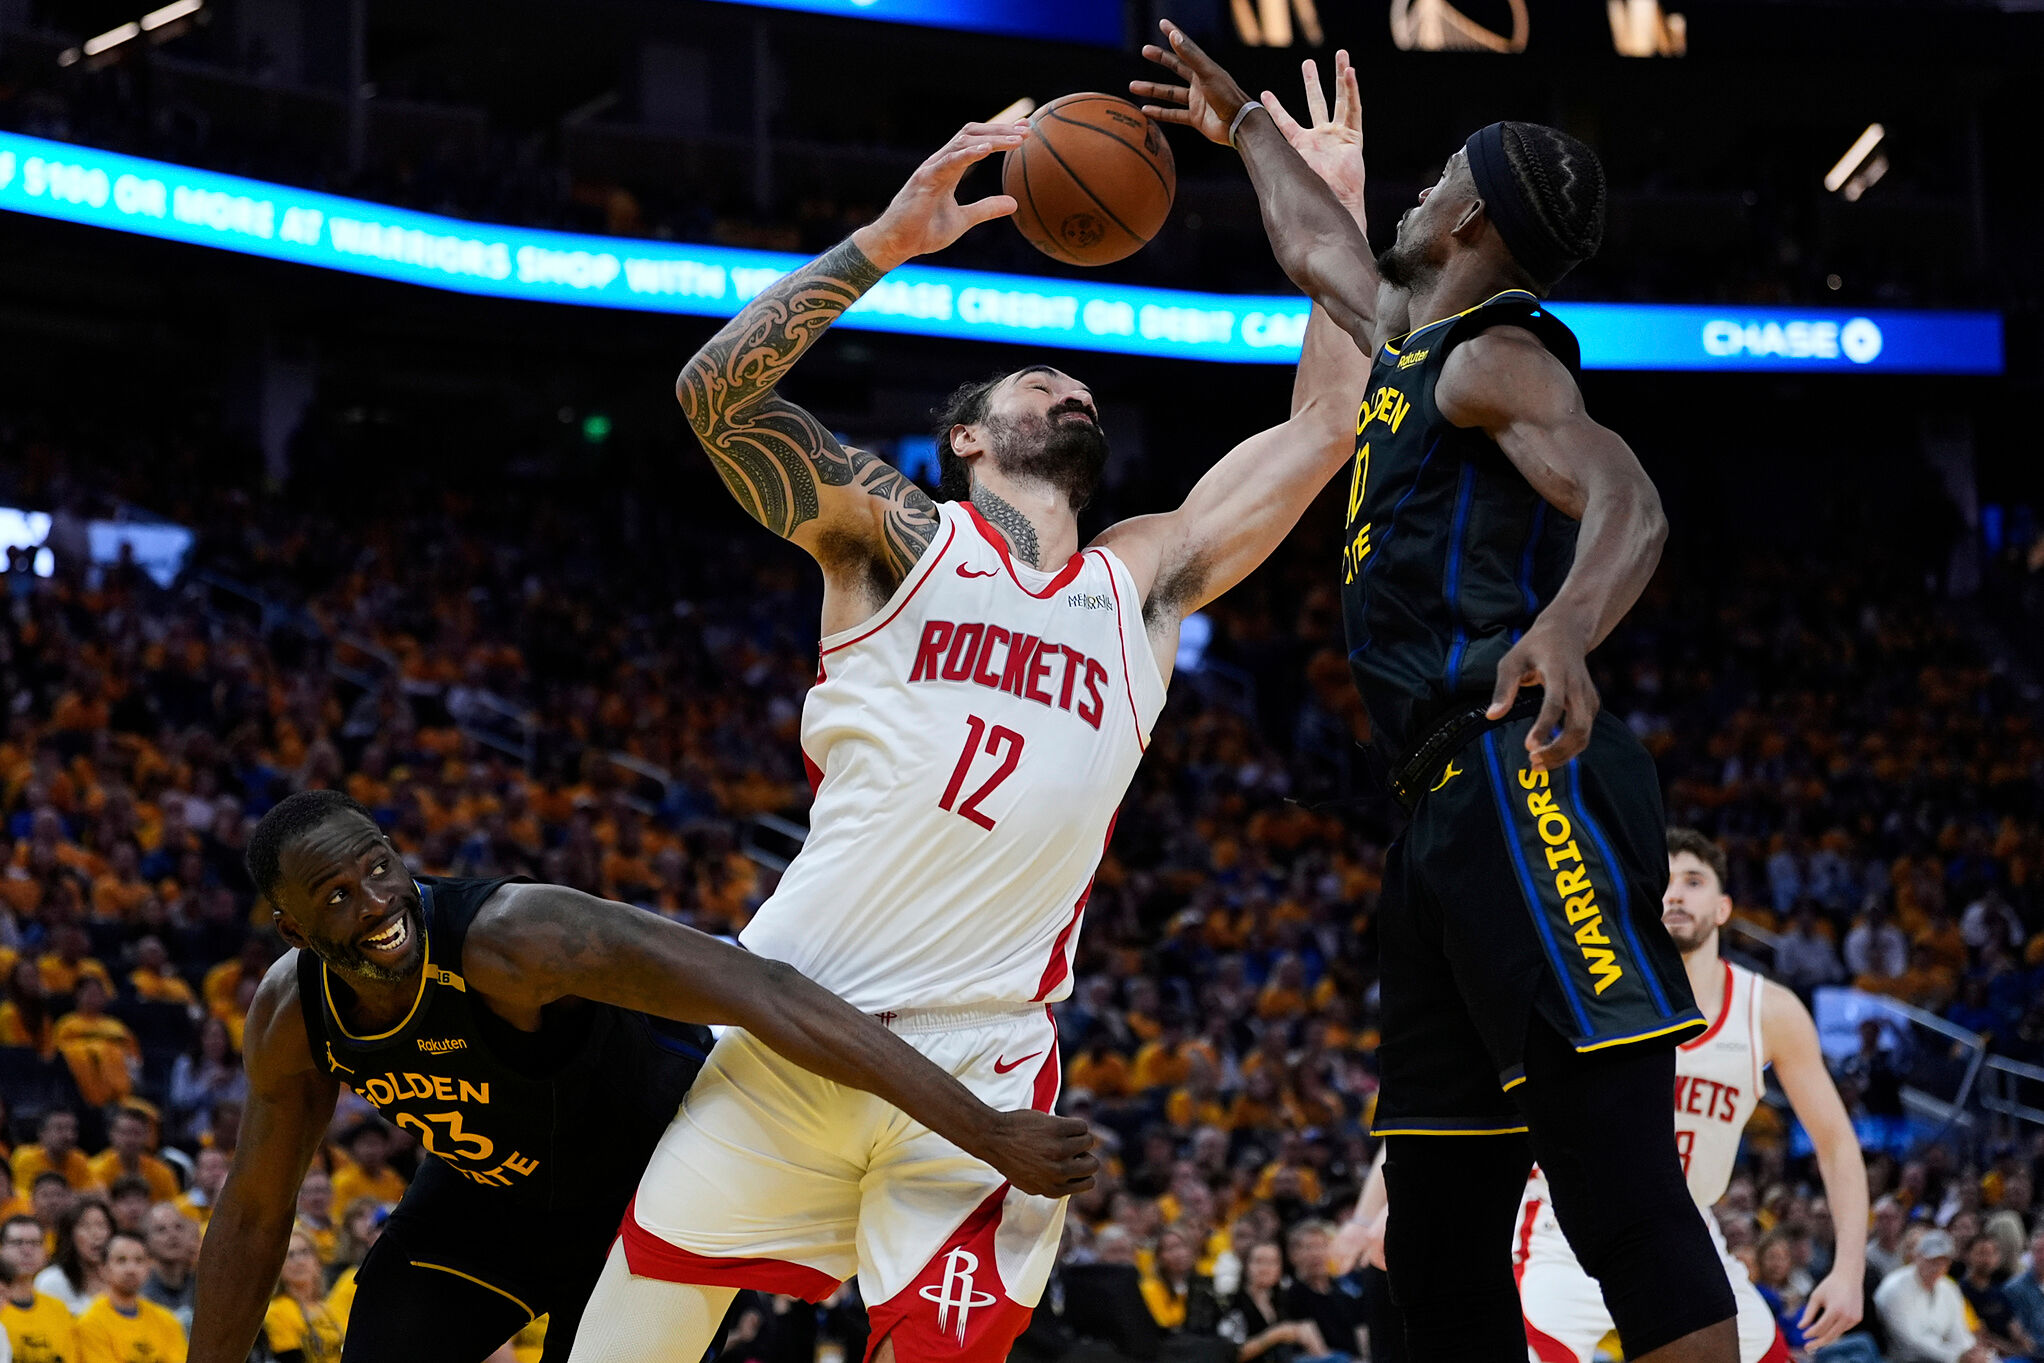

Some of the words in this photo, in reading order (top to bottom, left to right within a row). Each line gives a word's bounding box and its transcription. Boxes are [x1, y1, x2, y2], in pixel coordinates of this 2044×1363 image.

[23, 157, 110, 208] $100
[114, 174, 167, 218] OR
[173, 185, 274, 239] MORE
[279, 206, 323, 245] AT
[329, 217, 511, 281] WARRIORS
[516, 245, 621, 289] SHOP
[624, 258, 726, 299] WITH
[957, 287, 1079, 330] CREDIT
[1083, 299, 1134, 336] OR
[1139, 304, 1234, 344] DEBIT
[1398, 350, 1429, 369] Rakuten
[1702, 320, 1839, 359] CHASE
[908, 620, 1109, 732] ROCKETS
[938, 714, 1025, 832] 12
[1518, 768, 1623, 996] WARRIORS
[416, 1038, 468, 1052] Rakuten
[396, 1110, 494, 1161] 23
